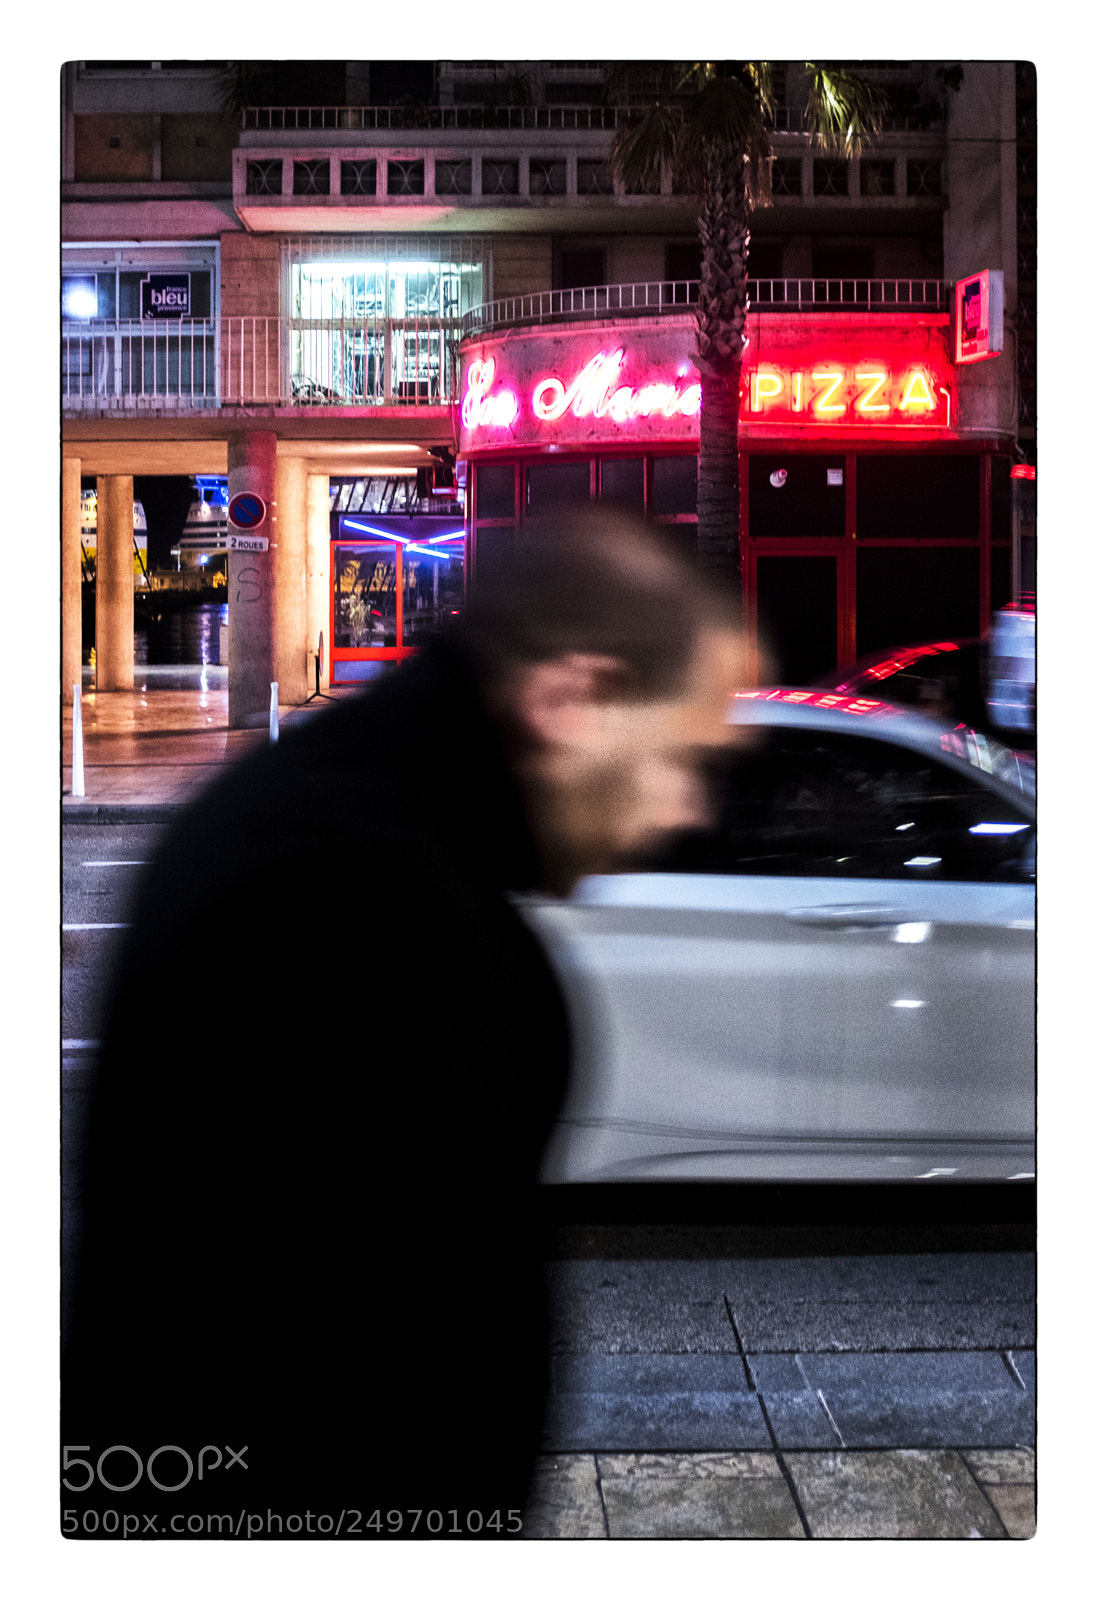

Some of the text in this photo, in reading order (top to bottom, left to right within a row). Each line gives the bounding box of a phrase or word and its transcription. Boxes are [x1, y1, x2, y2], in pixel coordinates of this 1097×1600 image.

[151, 289, 187, 305] bleu
[750, 372, 937, 413] PIZZA
[231, 537, 264, 549] 2 ROUES
